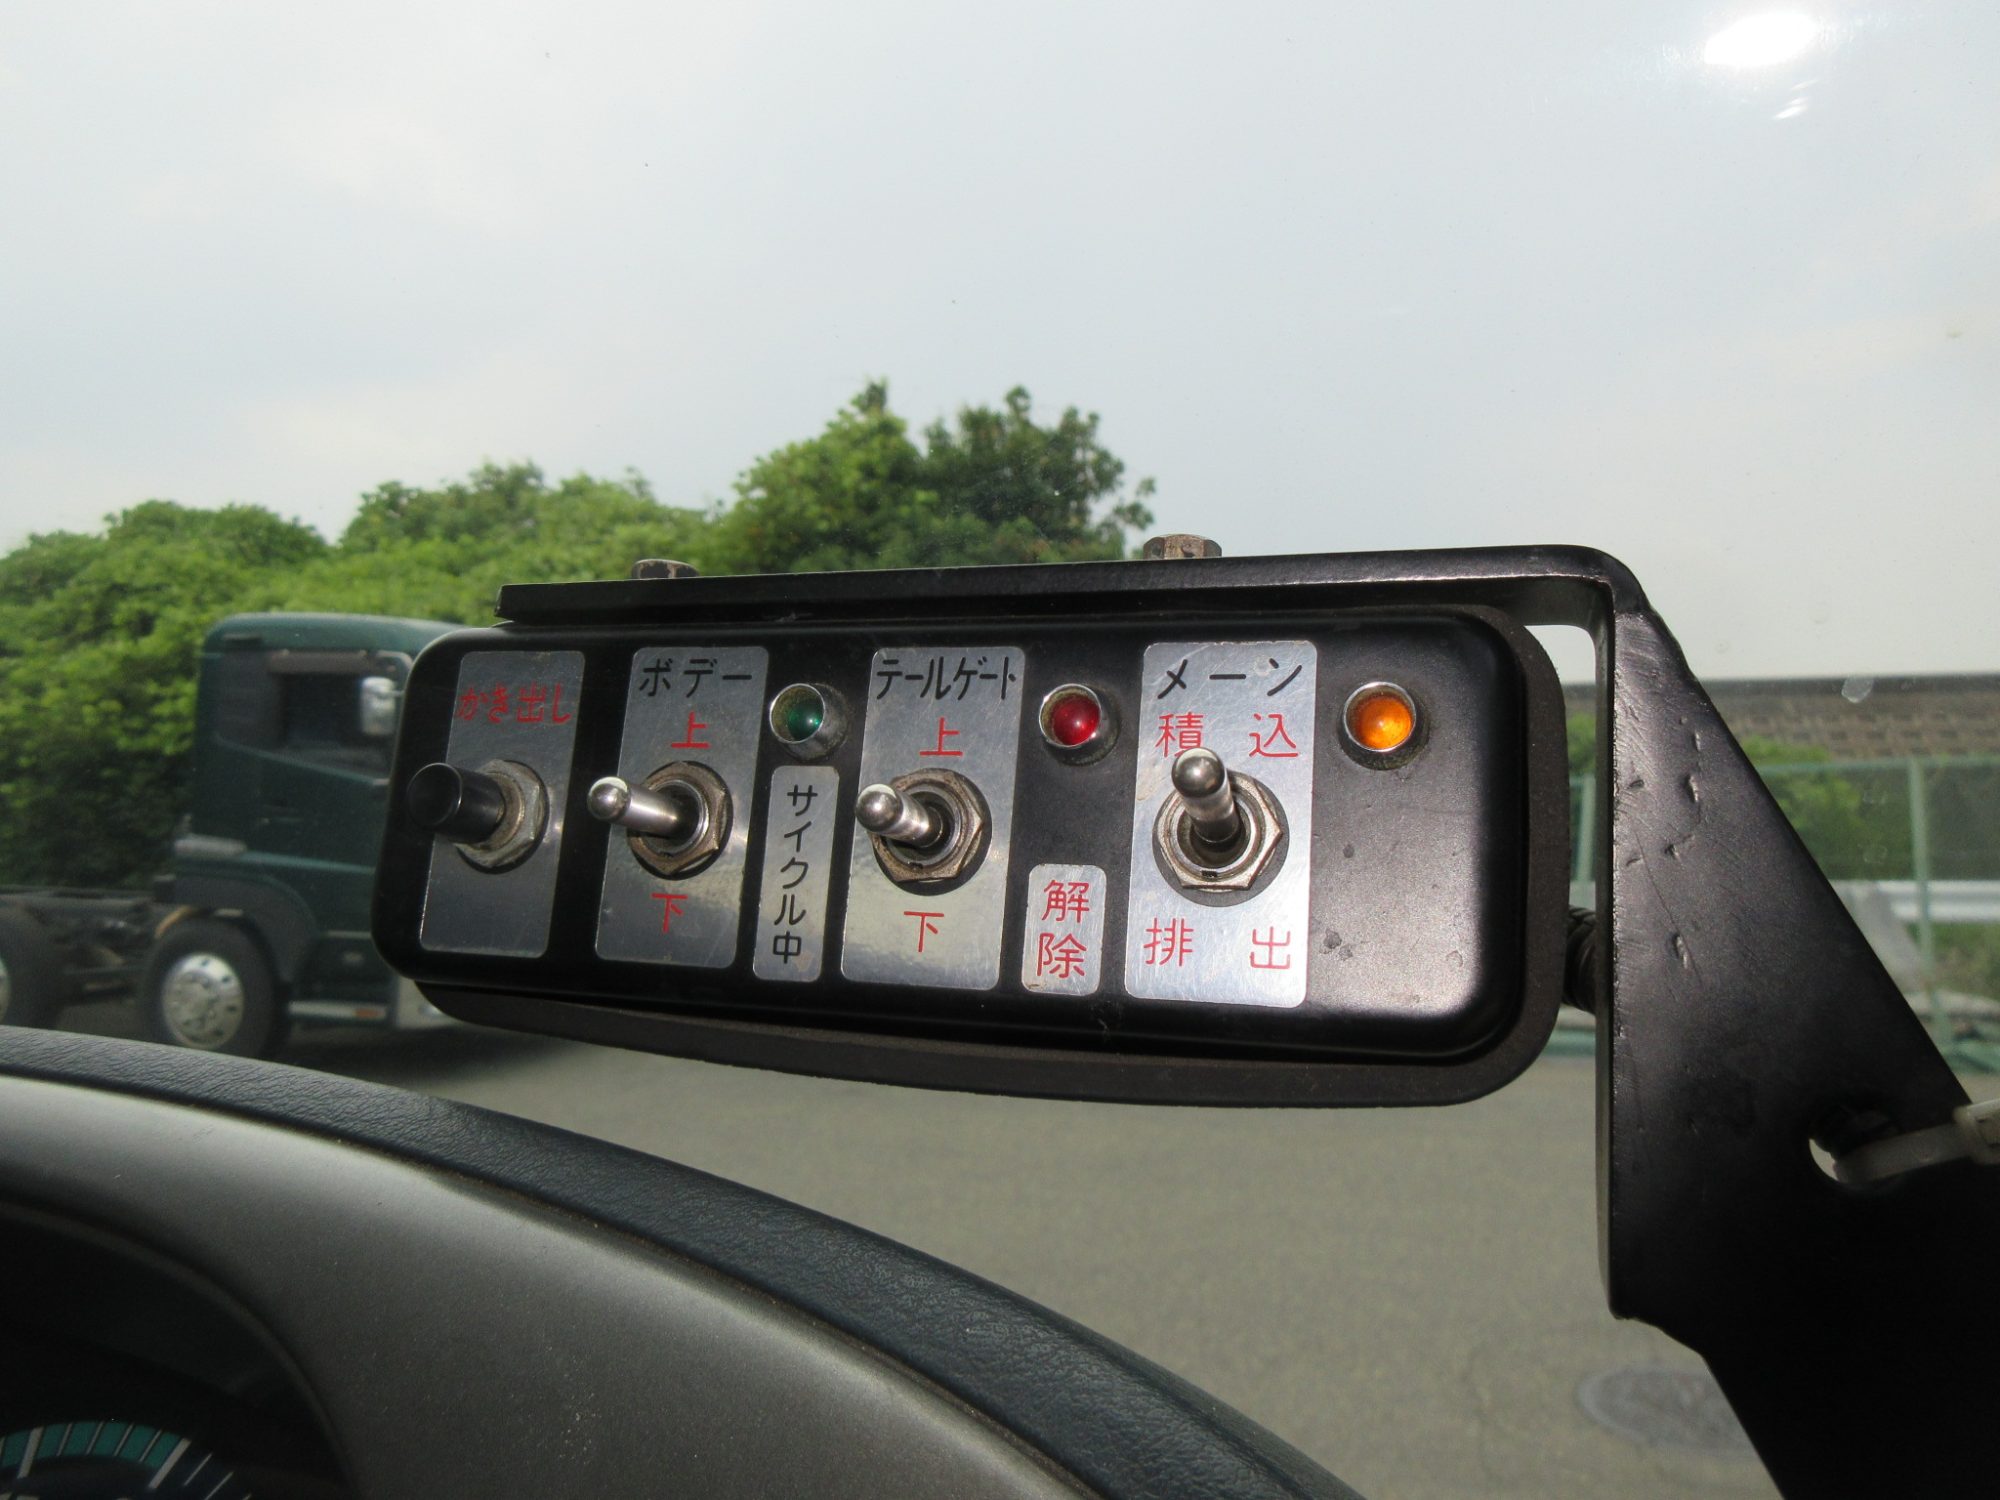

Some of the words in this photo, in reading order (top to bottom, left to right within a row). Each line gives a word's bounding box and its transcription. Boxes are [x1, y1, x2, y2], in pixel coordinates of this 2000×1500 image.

[639, 657, 752, 698] ボデー
[876, 655, 1018, 700] テールゲート
[1157, 658, 1303, 699] メーン
[455, 682, 572, 724] かき出し
[671, 711, 710, 748] 上
[919, 717, 963, 756] 上
[772, 784, 819, 964] サイクル中
[651, 893, 688, 932] 下
[903, 911, 945, 952] 下
[1036, 879, 1091, 979] 解除
